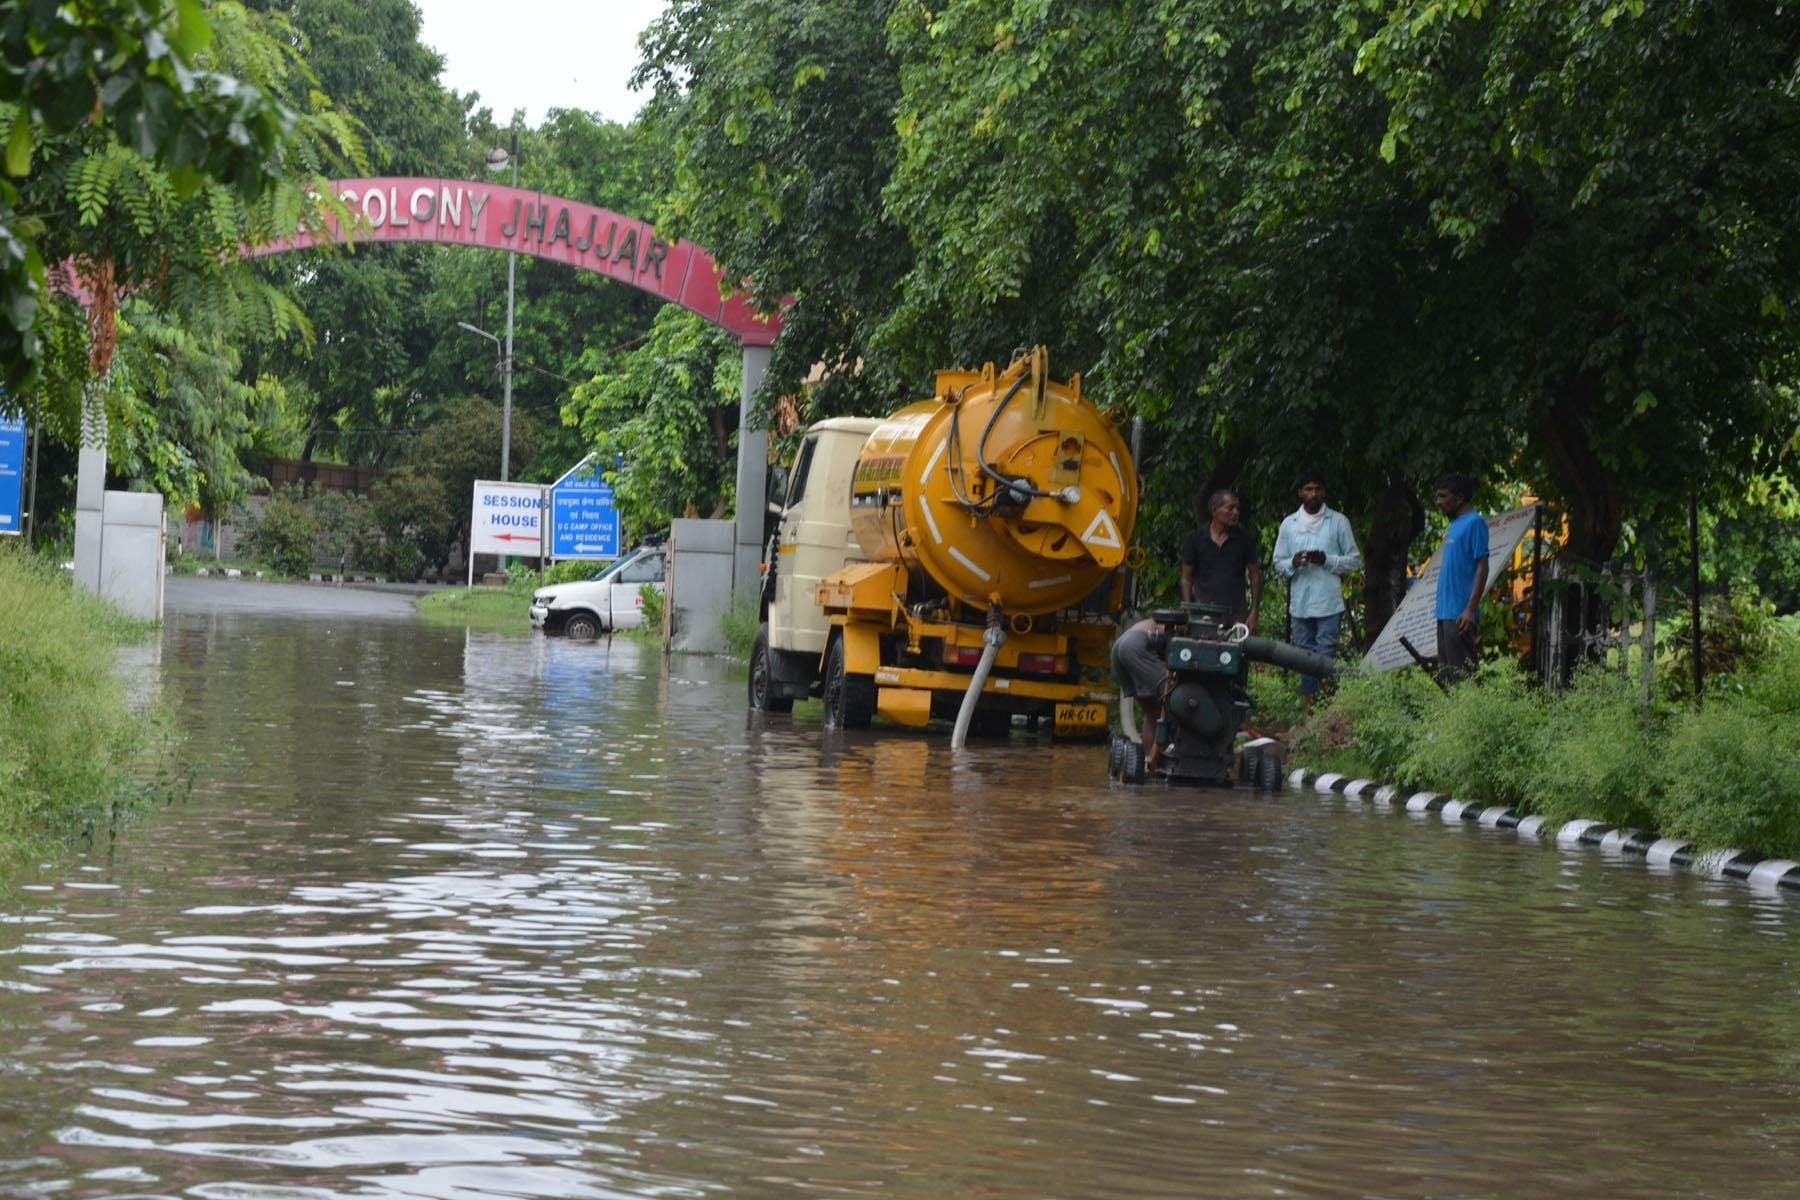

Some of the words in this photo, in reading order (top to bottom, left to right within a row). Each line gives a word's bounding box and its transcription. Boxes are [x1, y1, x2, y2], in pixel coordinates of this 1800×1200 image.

[501, 199, 668, 279] JHAJJAR
[491, 513, 538, 528] HOUSE
[570, 523, 588, 531] CAMP
[590, 523, 613, 532] OFFICE
[559, 533, 574, 542] AND
[575, 534, 611, 542] RESIDENCE
